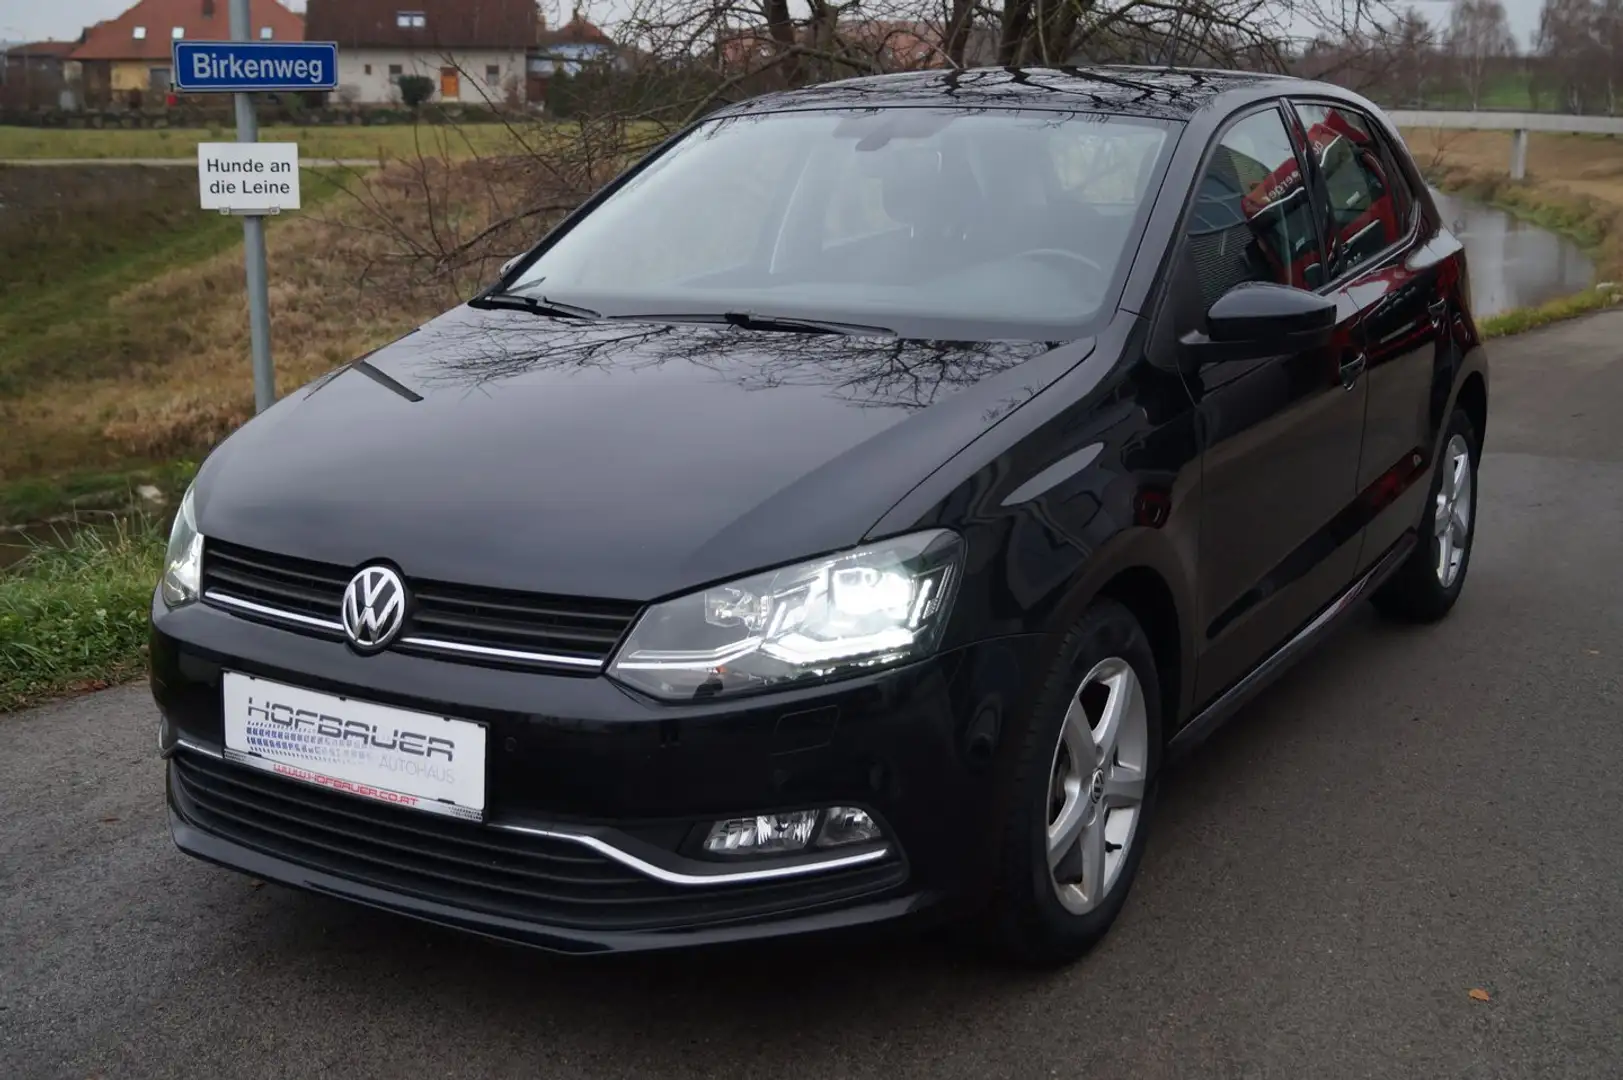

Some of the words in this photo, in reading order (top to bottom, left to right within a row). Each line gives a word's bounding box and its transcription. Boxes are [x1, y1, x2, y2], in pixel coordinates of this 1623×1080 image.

[192, 52, 323, 83] Birkenweg
[207, 159, 264, 173] Hunde
[270, 161, 291, 173] an
[209, 180, 236, 194] die
[242, 180, 290, 194] Leine
[342, 566, 405, 646] VW
[248, 697, 455, 762] HOFBAUER
[379, 754, 456, 784] AUTOHAUS
